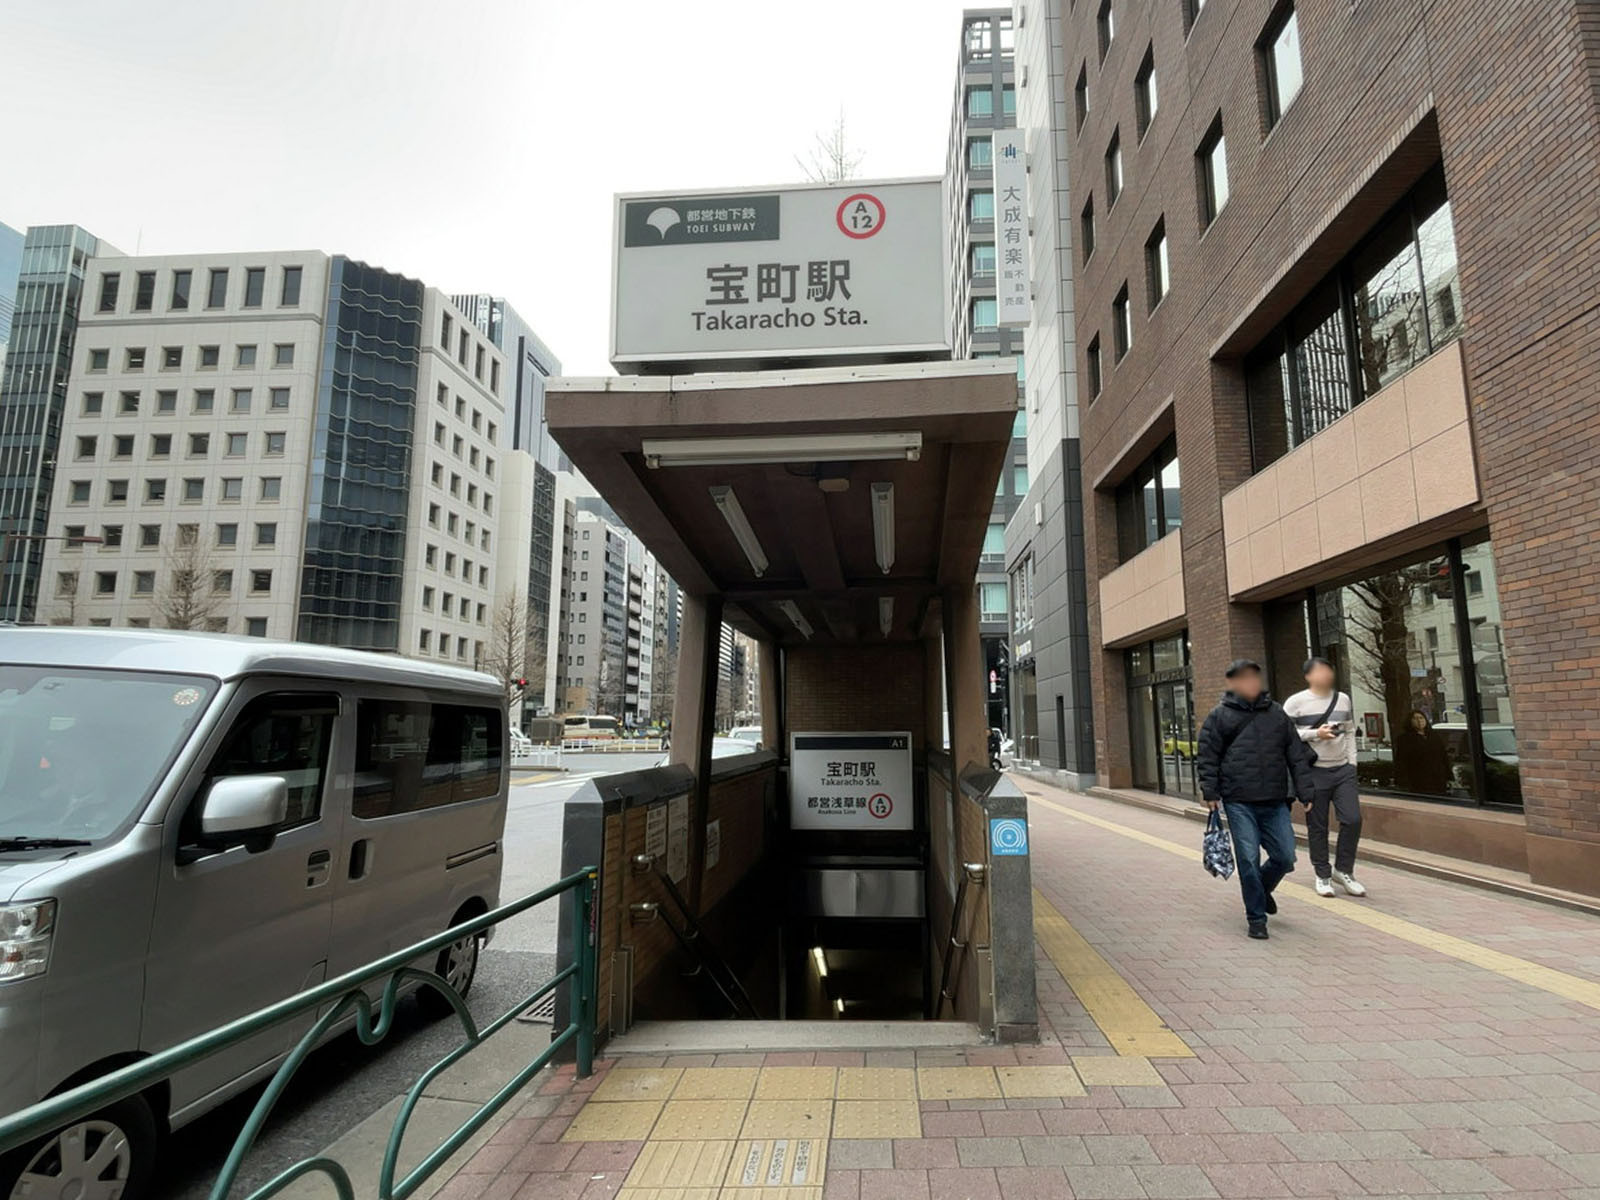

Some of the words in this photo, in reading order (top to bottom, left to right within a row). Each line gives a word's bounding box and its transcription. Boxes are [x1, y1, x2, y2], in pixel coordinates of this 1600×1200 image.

[855, 201, 868, 214] A
[687, 207, 757, 222] 都営地下鉄
[687, 224, 709, 234] TOEI
[713, 222, 756, 233] SUBWAY
[851, 214, 873, 230] 12
[705, 259, 852, 306] 宝町駅
[691, 308, 816, 332] Takaracho
[824, 307, 868, 327] Sta.
[892, 740, 903, 748] A1
[827, 761, 876, 777] 宝町駅
[821, 778, 864, 786] Takaracho
[866, 778, 881, 786] Sta.
[807, 796, 867, 809] 都営浅草線
[876, 797, 884, 805] A
[875, 806, 887, 814] 12
